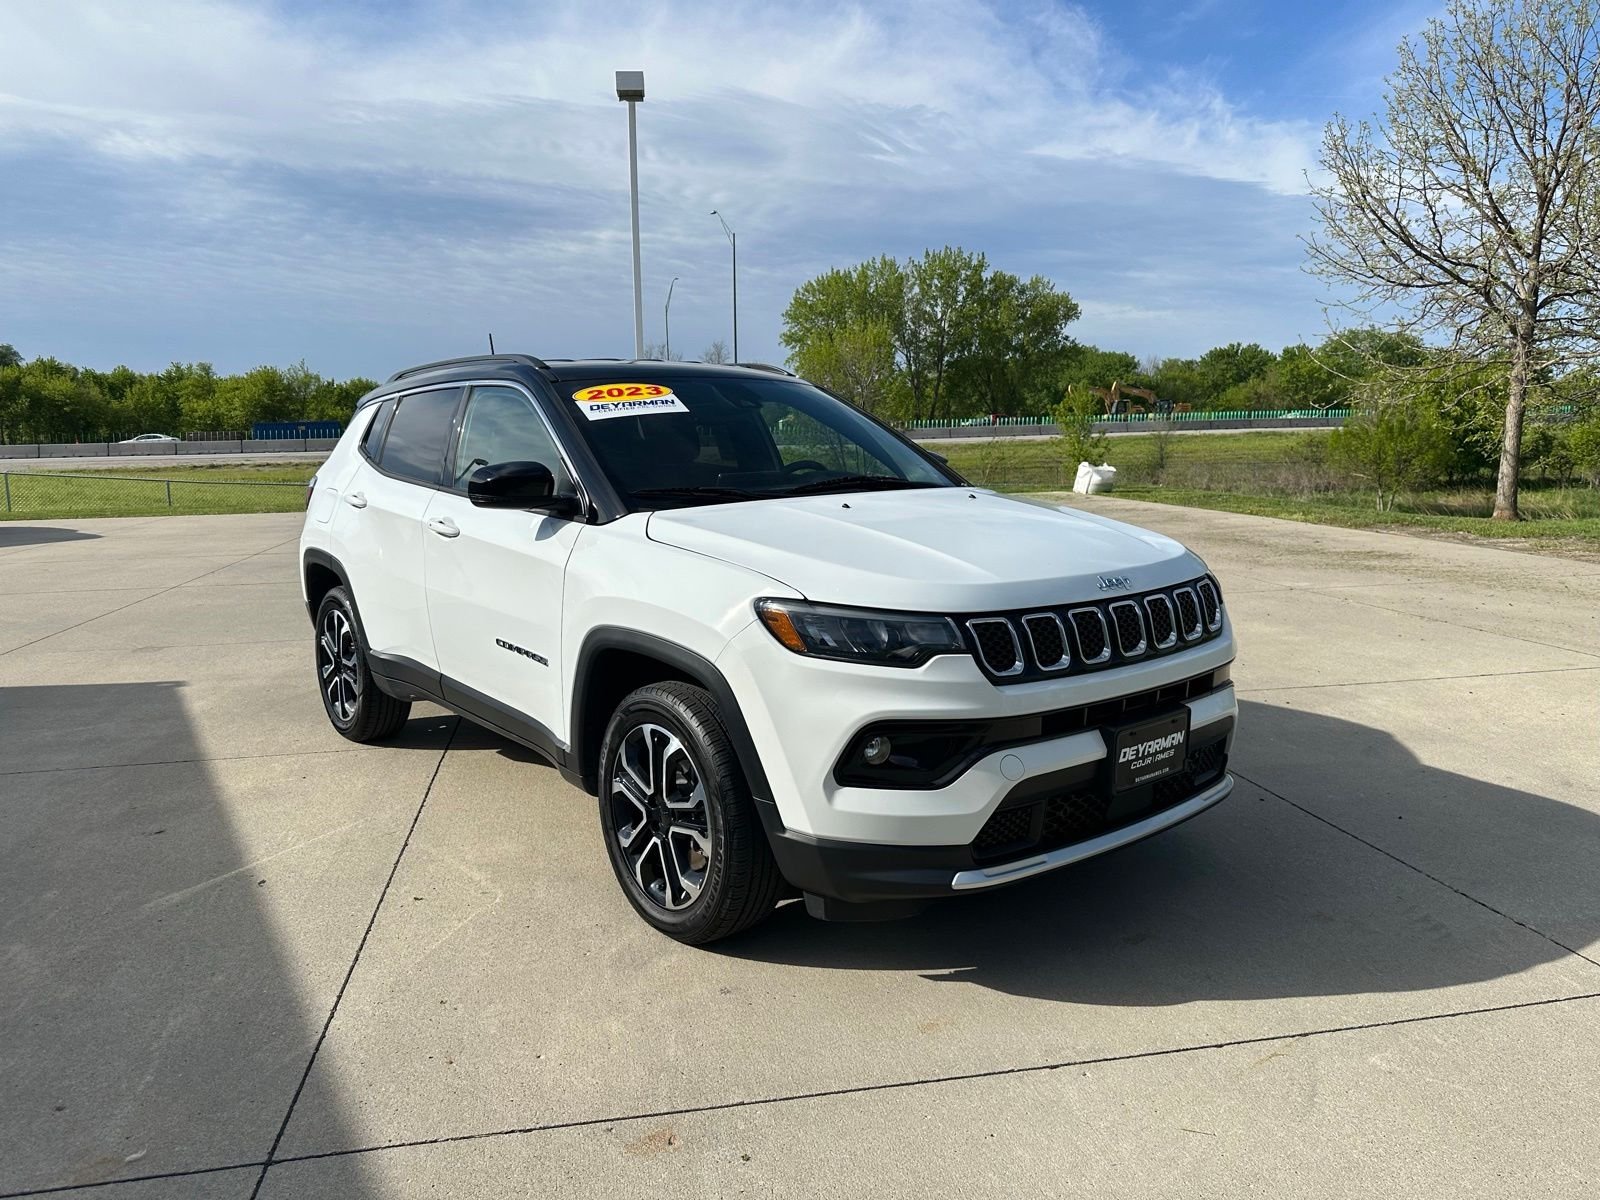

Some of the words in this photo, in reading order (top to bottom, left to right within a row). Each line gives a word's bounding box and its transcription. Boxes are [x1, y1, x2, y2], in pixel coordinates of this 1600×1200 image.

[587, 386, 664, 400] 2023
[589, 399, 675, 411] DEYARMAN
[1096, 575, 1130, 591] Jeep
[495, 638, 549, 667] COMPASS
[1119, 730, 1185, 763] DEYARMAN
[1154, 748, 1175, 762] AMES
